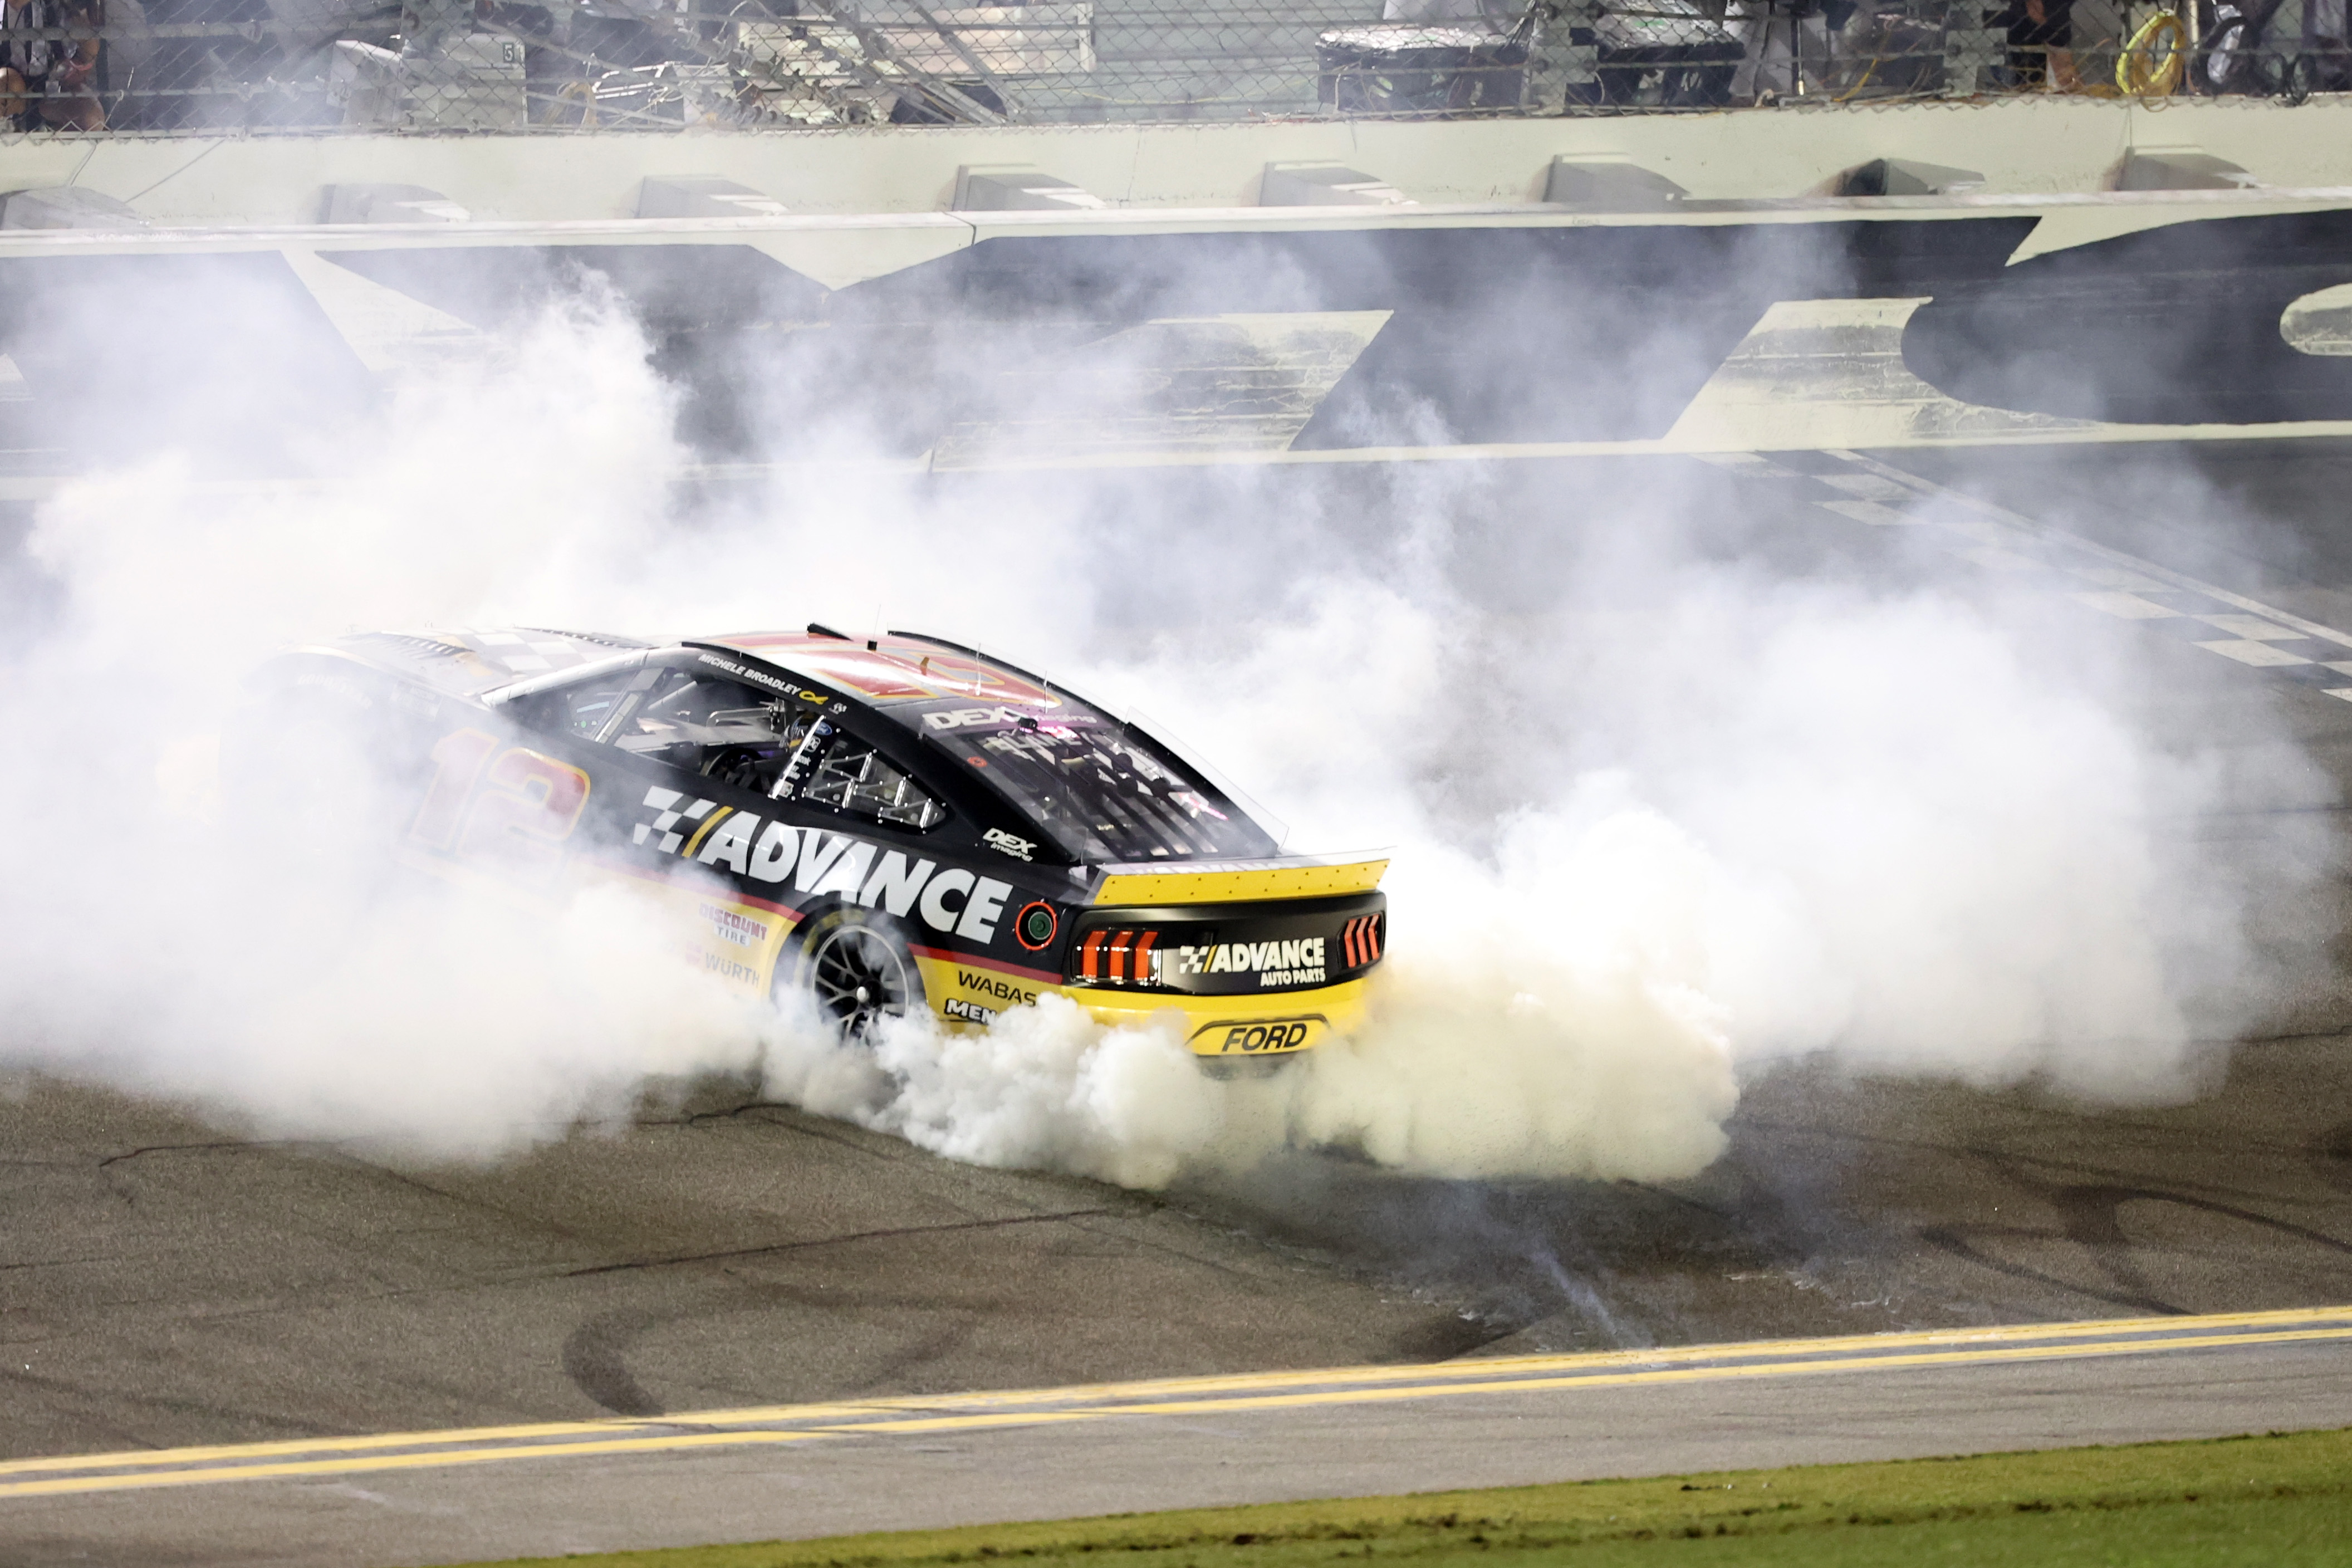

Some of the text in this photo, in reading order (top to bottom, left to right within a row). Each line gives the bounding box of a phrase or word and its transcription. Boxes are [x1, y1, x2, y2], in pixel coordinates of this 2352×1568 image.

[504, 44, 513, 62] 5
[698, 653, 802, 695] MICHELE BROADLEY
[922, 705, 1030, 730] DEX
[408, 726, 591, 877] 12
[982, 827, 1038, 855] DEX
[697, 810, 1013, 944] ADVANCE
[699, 903, 768, 941] DISCOUNT
[717, 925, 747, 945] TIRE
[705, 953, 760, 989] WÜRTH
[1209, 937, 1325, 973] ADVANCE
[958, 970, 1037, 1007] WABAS
[1260, 967, 1326, 987] AUTO PARTS
[944, 998, 999, 1026] MEN
[1221, 1022, 1307, 1052] FORD
